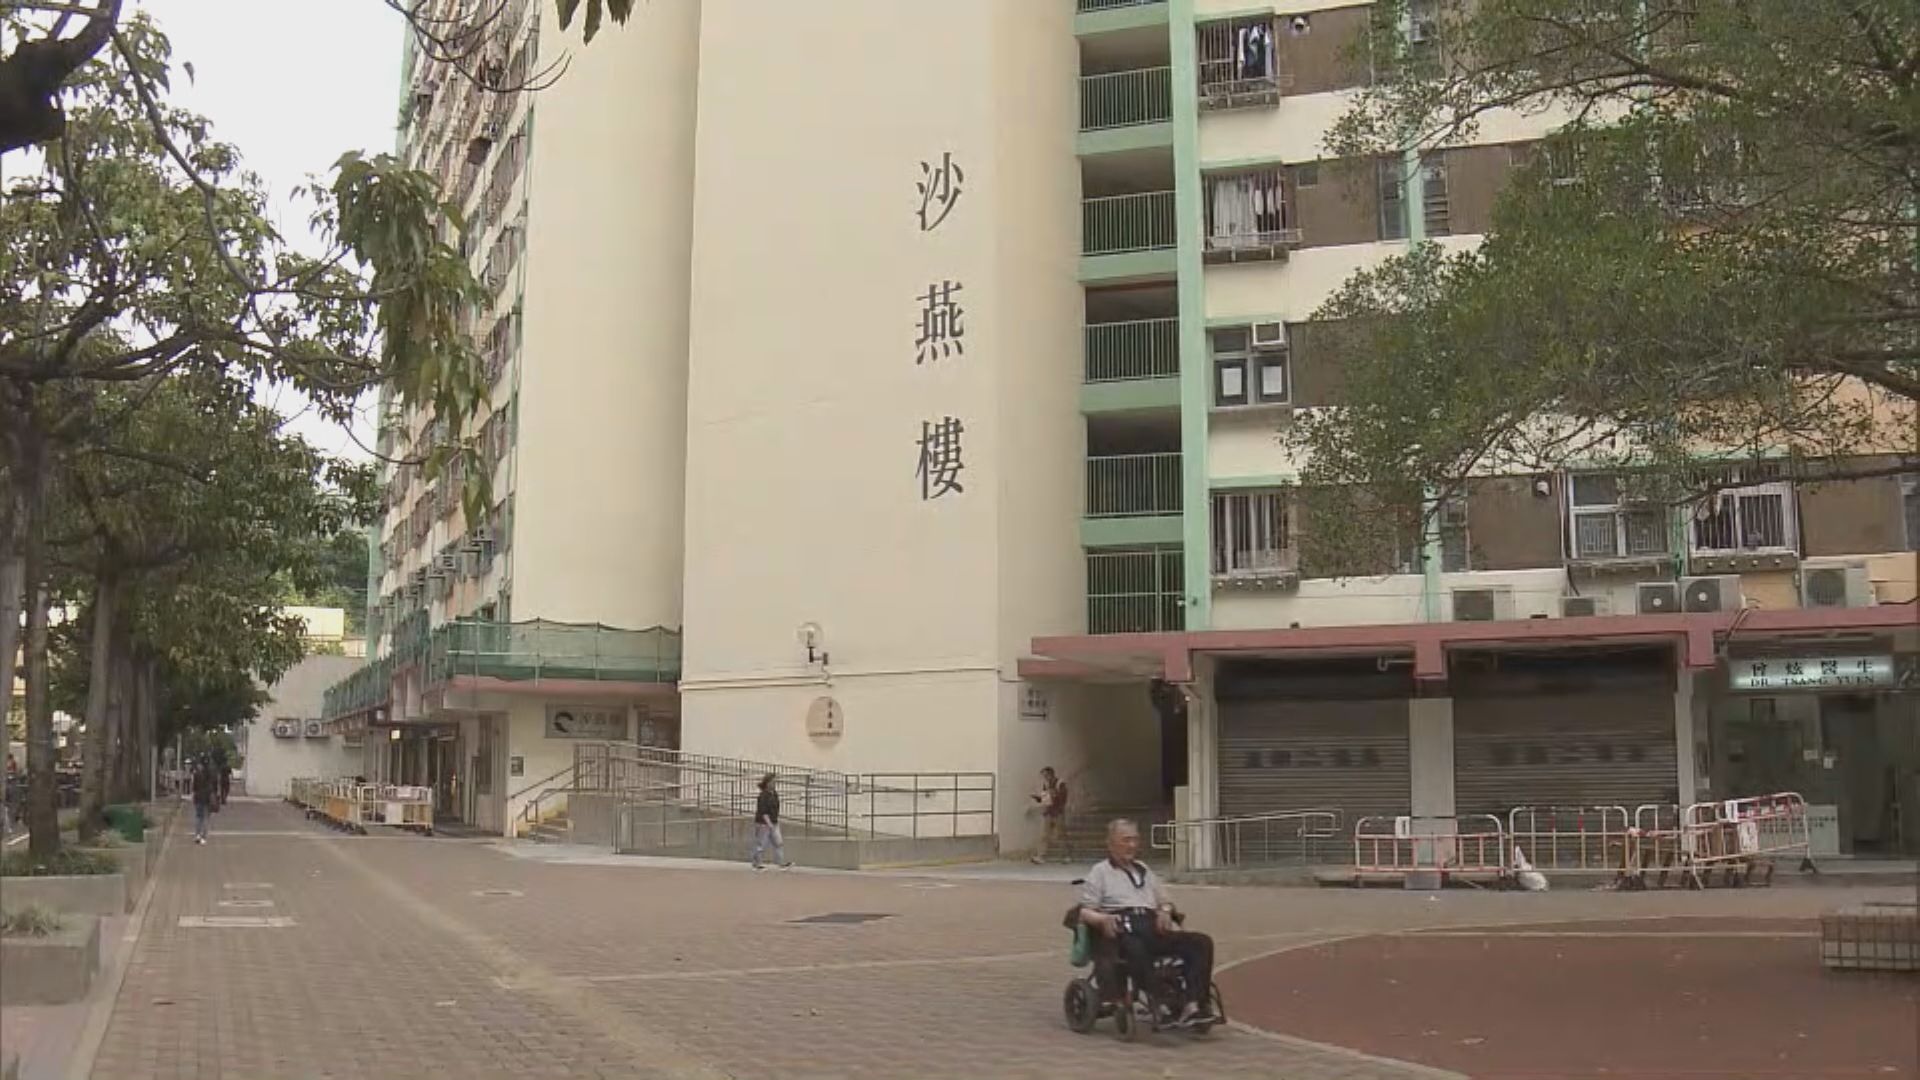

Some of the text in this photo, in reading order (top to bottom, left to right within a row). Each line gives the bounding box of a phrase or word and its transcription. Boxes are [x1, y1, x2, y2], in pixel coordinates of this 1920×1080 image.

[915, 151, 965, 501] 沙燕樓
[1783, 677, 1828, 687] TSANG
[1837, 675, 1874, 686] YUEN
